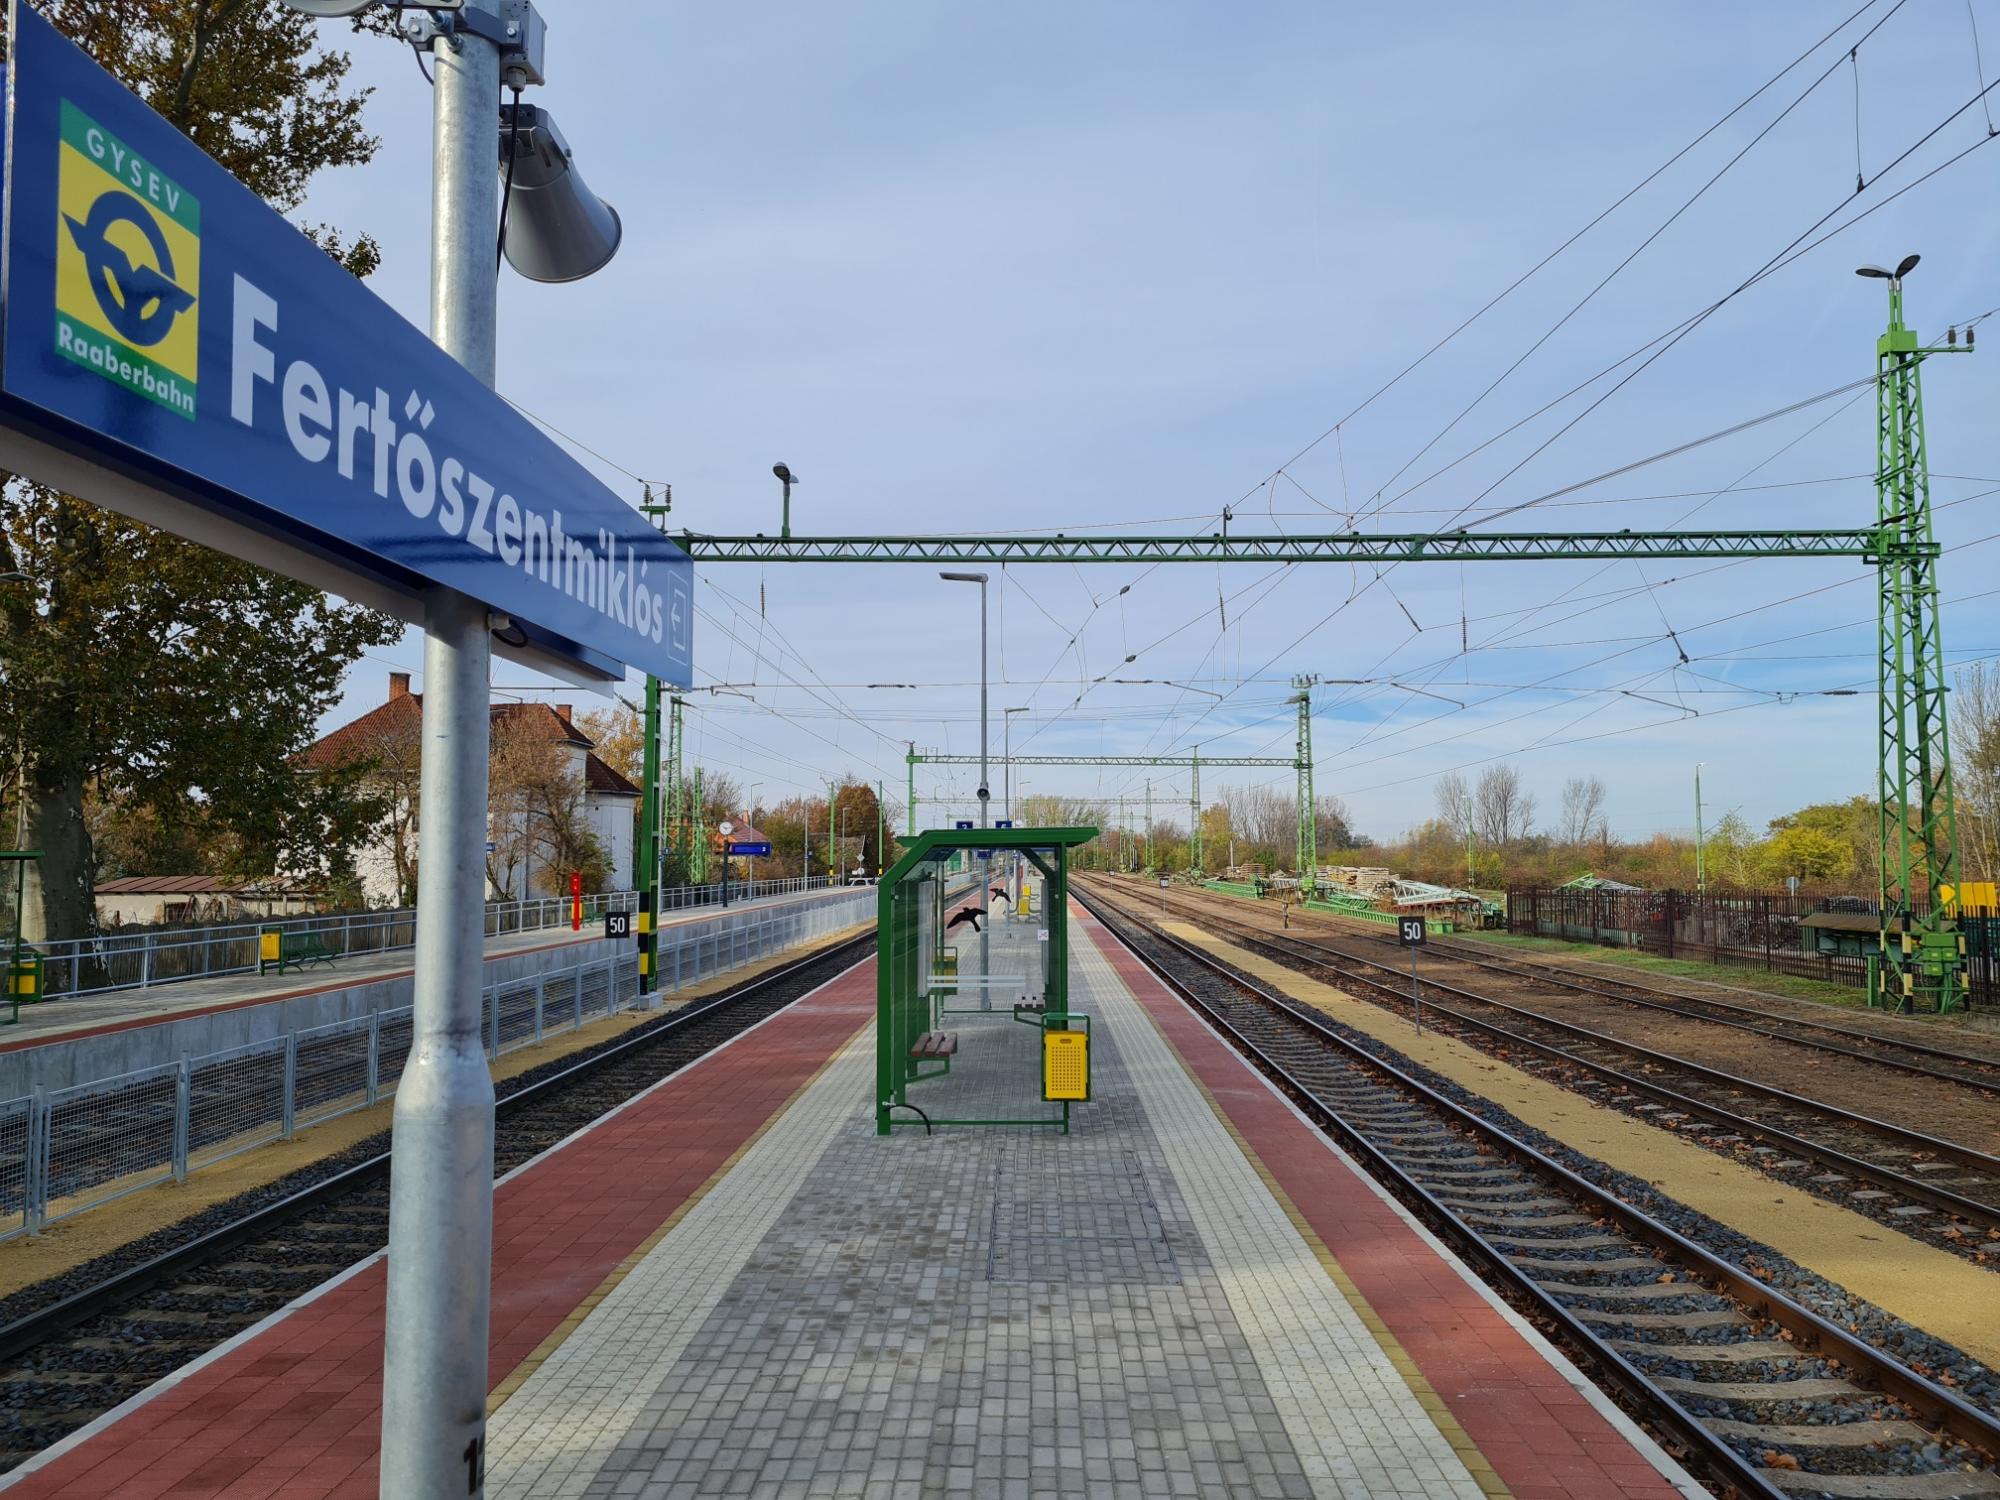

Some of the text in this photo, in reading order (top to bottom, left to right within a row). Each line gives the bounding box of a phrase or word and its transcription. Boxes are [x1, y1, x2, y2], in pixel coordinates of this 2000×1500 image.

[86, 128, 180, 213] GYSEV
[58, 321, 195, 413] Raaberbahn
[231, 272, 663, 644] Fertőszentmiklós
[610, 916, 625, 934] 50
[1403, 921, 1421, 940] 50
